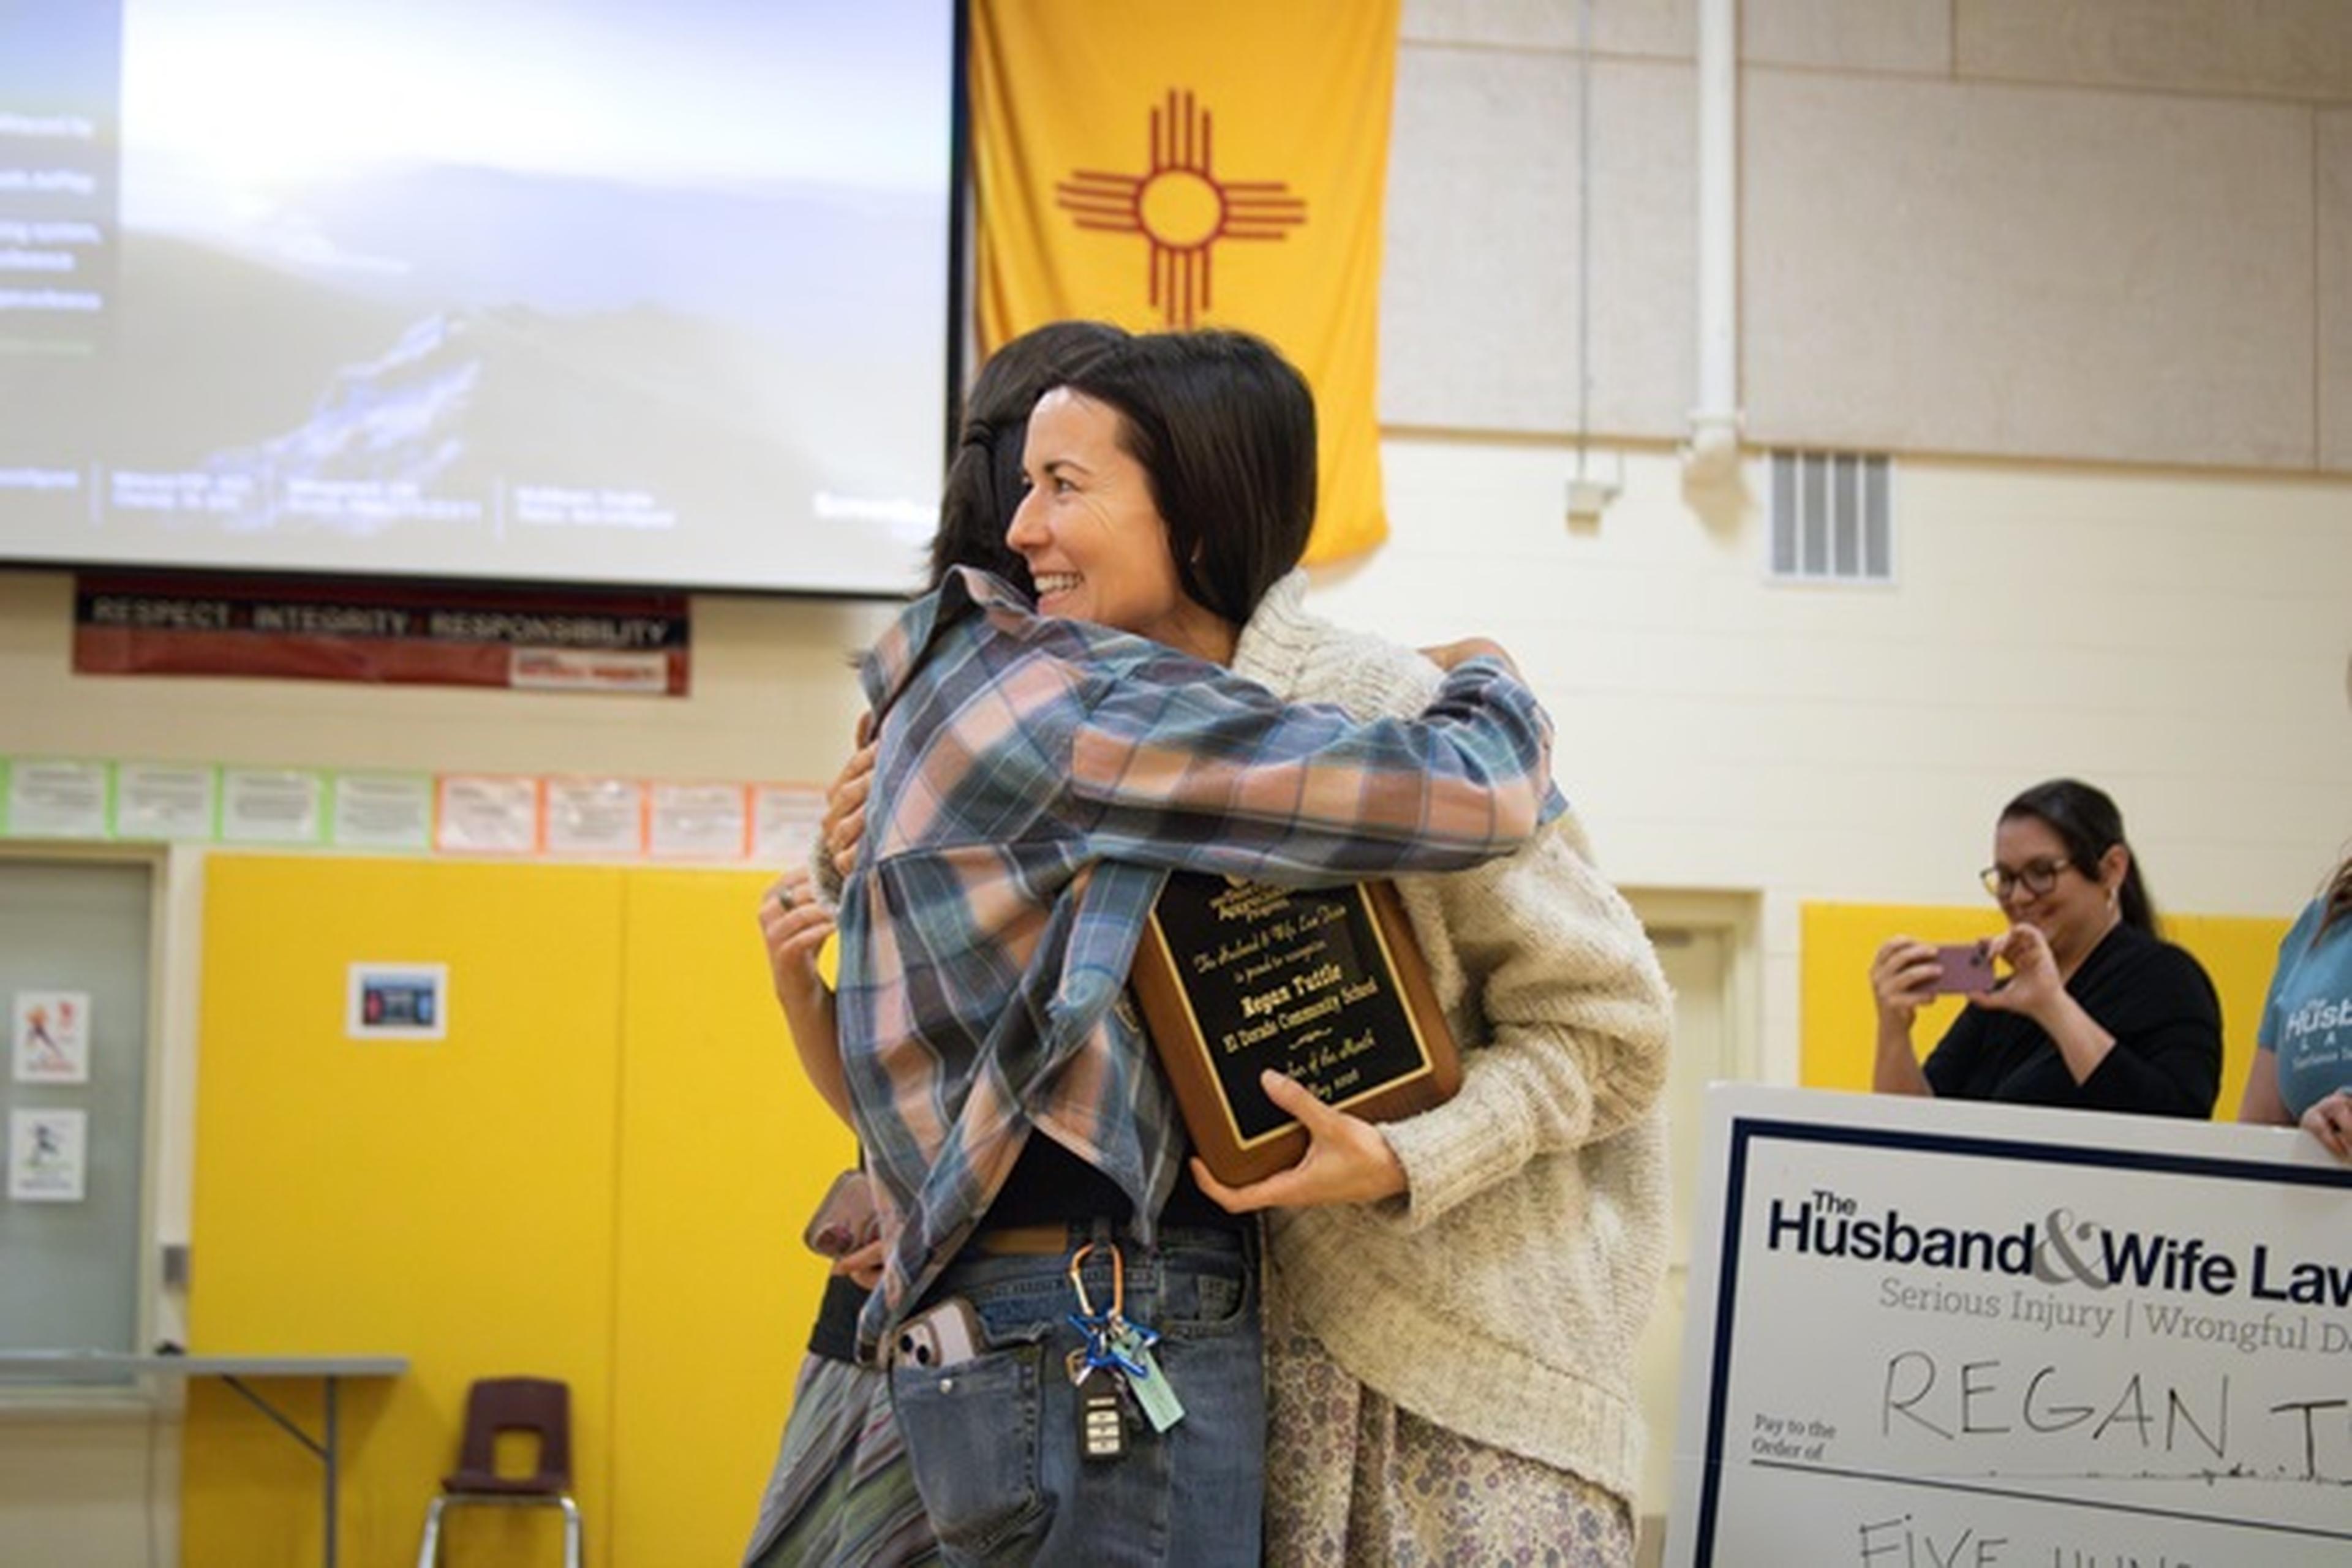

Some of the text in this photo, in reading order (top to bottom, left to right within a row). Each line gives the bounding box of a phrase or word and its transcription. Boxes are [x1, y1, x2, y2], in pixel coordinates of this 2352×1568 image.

[94, 595, 668, 646] RESPECT INTEGRITY RESPONSIBILITY
[1237, 1020, 1278, 1047] Dorado
[1278, 995, 1343, 1030] Community
[1340, 975, 1379, 1005] School
[1240, 963, 1343, 1019] Regan Tuttle
[1812, 1189, 1858, 1216] The
[1768, 1198, 2036, 1276] Husband
[2100, 1229, 2237, 1296] Wife
[1879, 1275, 2001, 1319] Serious
[2010, 1291, 2114, 1339] Injury
[2144, 1302, 2309, 1353] Wrongful
[2320, 1321, 2352, 1354] D
[1754, 1413, 1837, 1440] Pay to the
[1882, 1349, 2352, 1483] REGAN T
[1751, 1436, 1825, 1461] Order of
